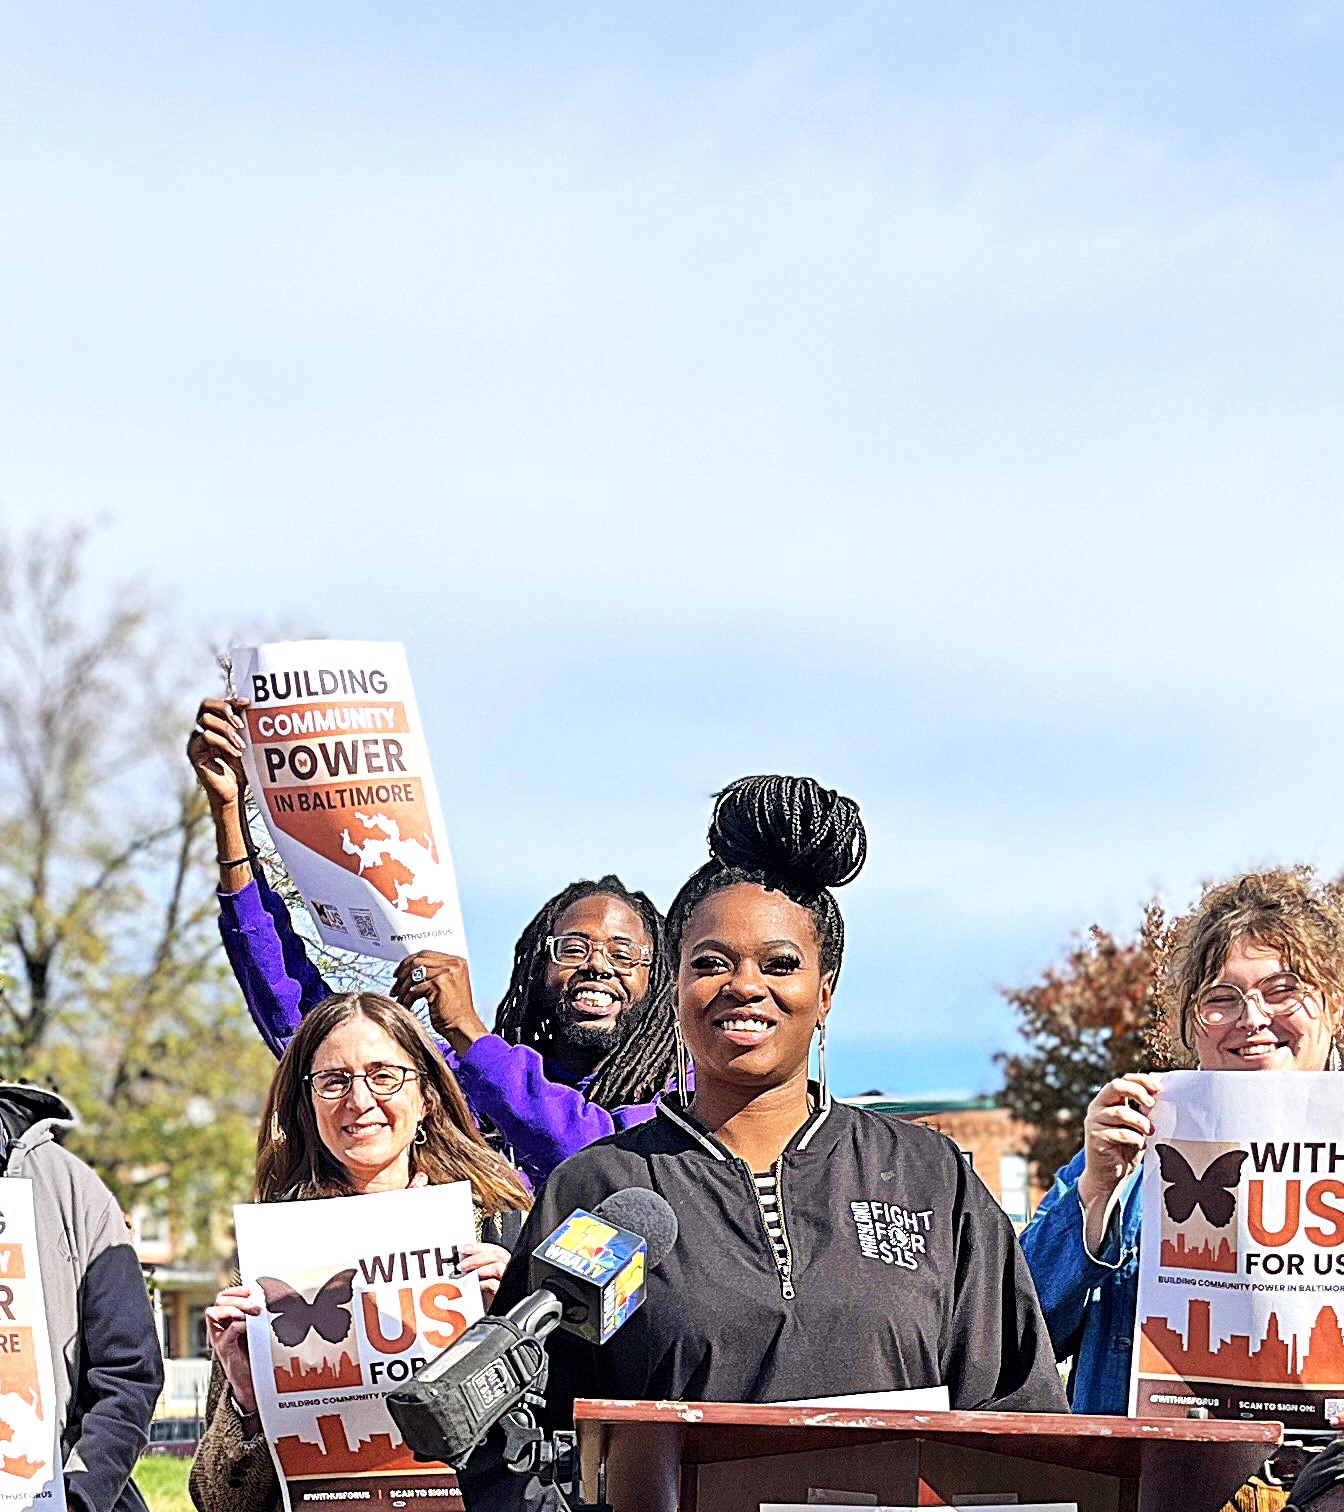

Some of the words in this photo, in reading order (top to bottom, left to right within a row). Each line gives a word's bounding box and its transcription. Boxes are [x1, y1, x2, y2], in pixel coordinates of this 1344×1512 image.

[252, 669, 388, 703] BUILDING
[258, 707, 395, 737] COMMUNITY
[263, 739, 408, 783] POWER
[273, 794, 295, 815] IN
[299, 784, 414, 812] BALTIMORE
[871, 1202, 933, 1232] FIGHT
[359, 1246, 460, 1285] WITH
[1246, 1252, 1305, 1276] FOR
[1158, 1276, 1196, 1286] BUILDING
[1198, 1280, 1250, 1291] COMMUNITY
[1252, 1284, 1286, 1292] POWER
[361, 1283, 467, 1354] US
[279, 1400, 320, 1408] BUILDING
[322, 1393, 379, 1404] COMMUNITY
[1239, 1401, 1263, 1410] SCAN
[1277, 1403, 1298, 1412] SIGN
[390, 1490, 414, 1498] SCAN
[415, 1489, 427, 1497] TO
